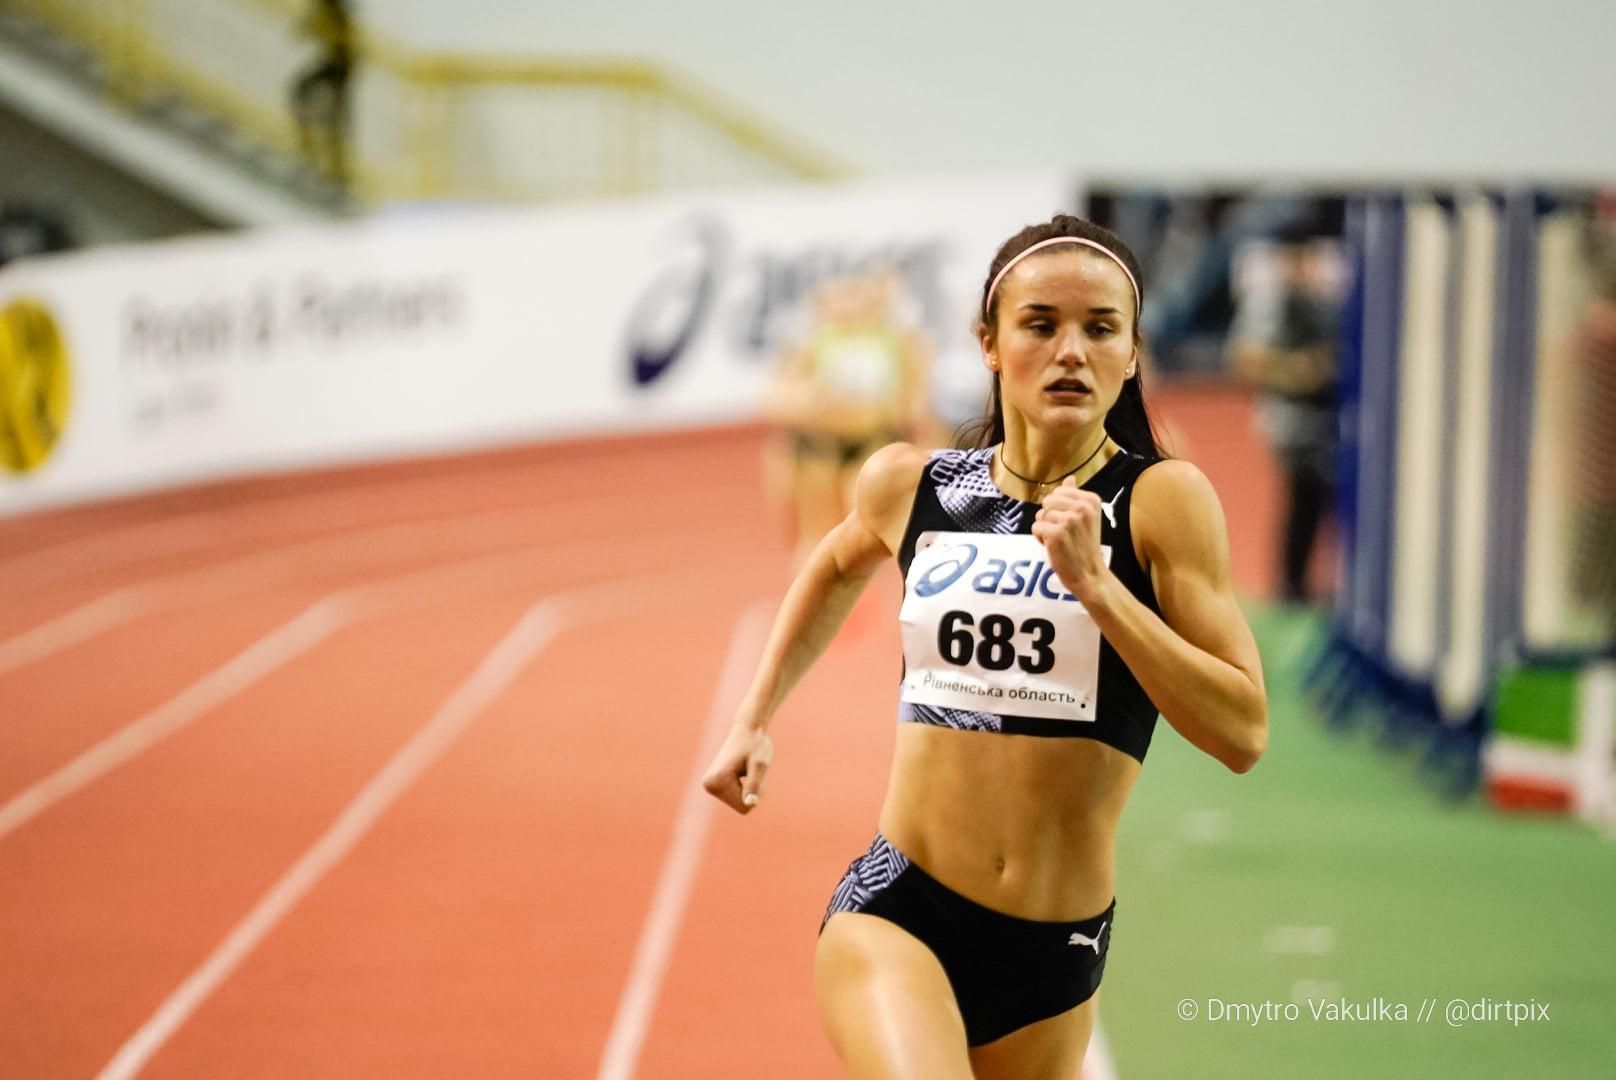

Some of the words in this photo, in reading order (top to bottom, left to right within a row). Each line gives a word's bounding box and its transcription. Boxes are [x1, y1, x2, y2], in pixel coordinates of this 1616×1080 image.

[972, 558, 1082, 602] asic
[937, 610, 1056, 675] 683
[923, 672, 1003, 698] Рівненська
[1008, 686, 1076, 704] область
